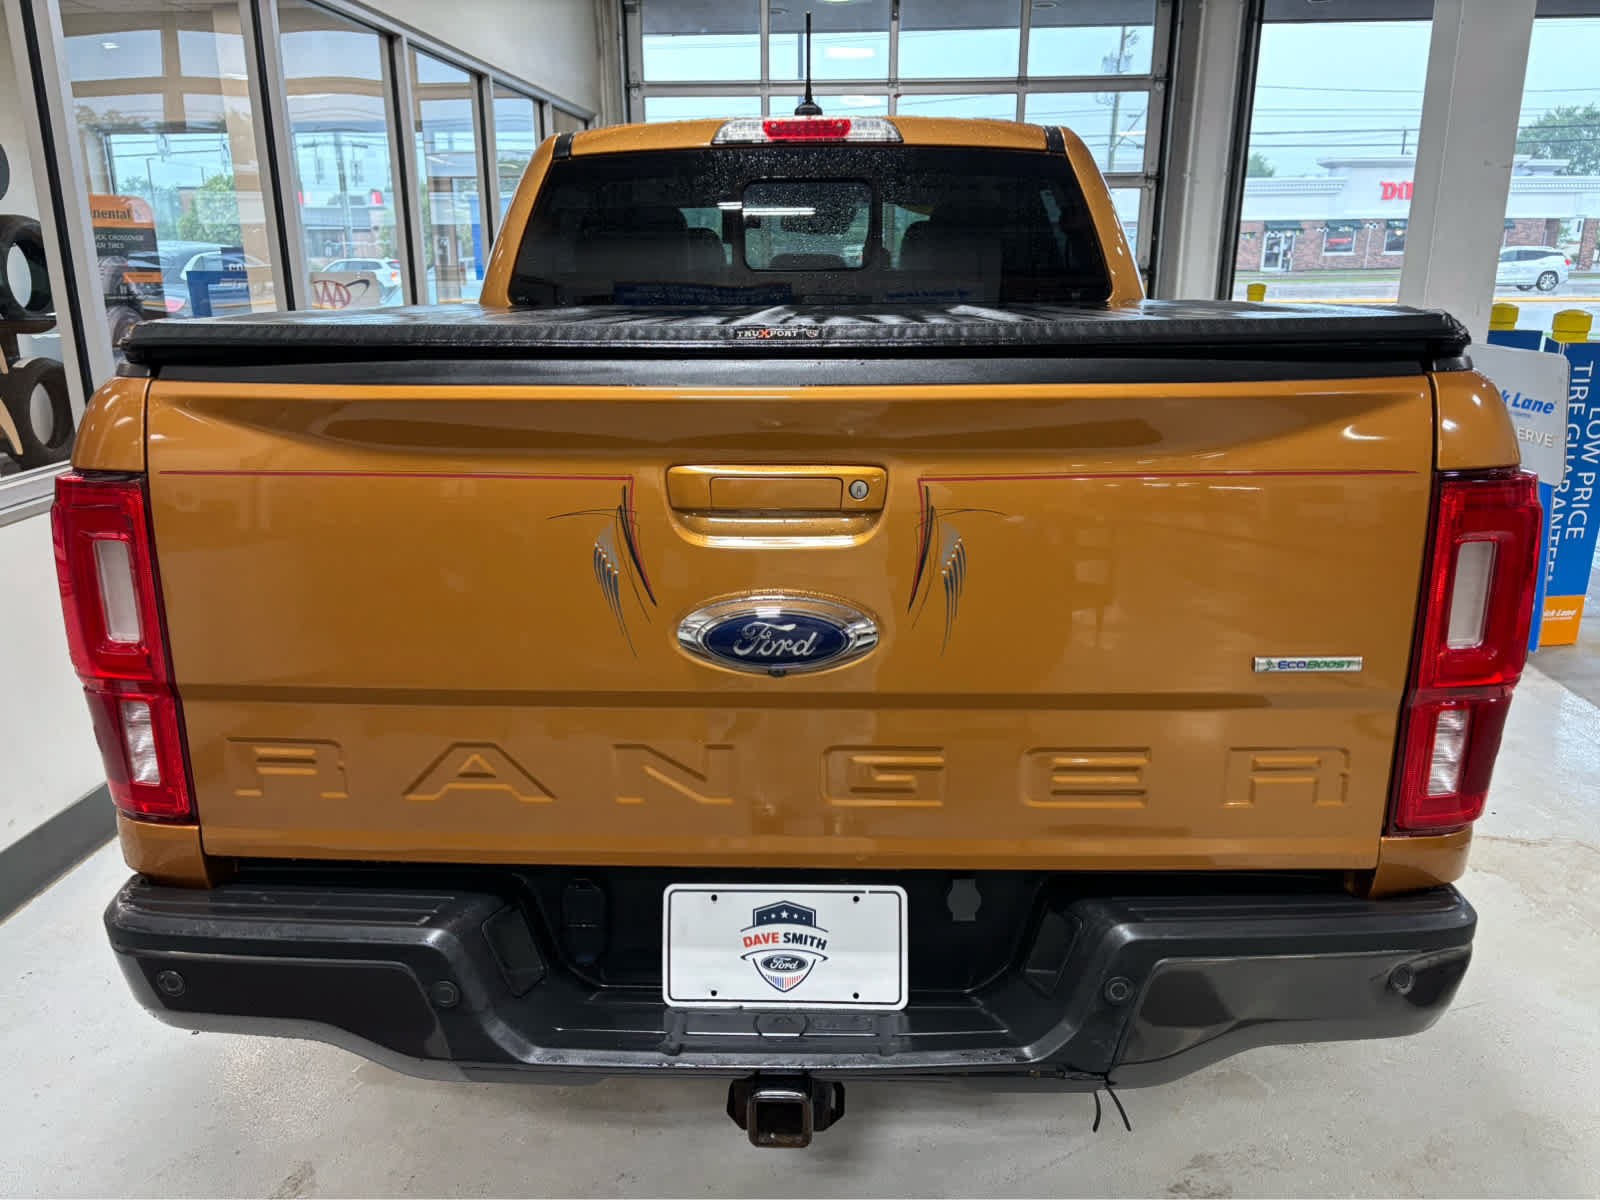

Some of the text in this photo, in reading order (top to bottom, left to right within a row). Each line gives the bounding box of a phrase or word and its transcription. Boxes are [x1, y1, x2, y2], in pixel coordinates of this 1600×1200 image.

[737, 329, 798, 338] TRUXPORT
[1511, 391, 1556, 415] Lane
[1568, 360, 1595, 416] TIRE
[1565, 471, 1597, 540] PRICE
[732, 621, 818, 657] Ford
[226, 737, 1350, 808] RANGER
[743, 932, 827, 950] DAVE SMITH
[770, 957, 799, 970] Ford
